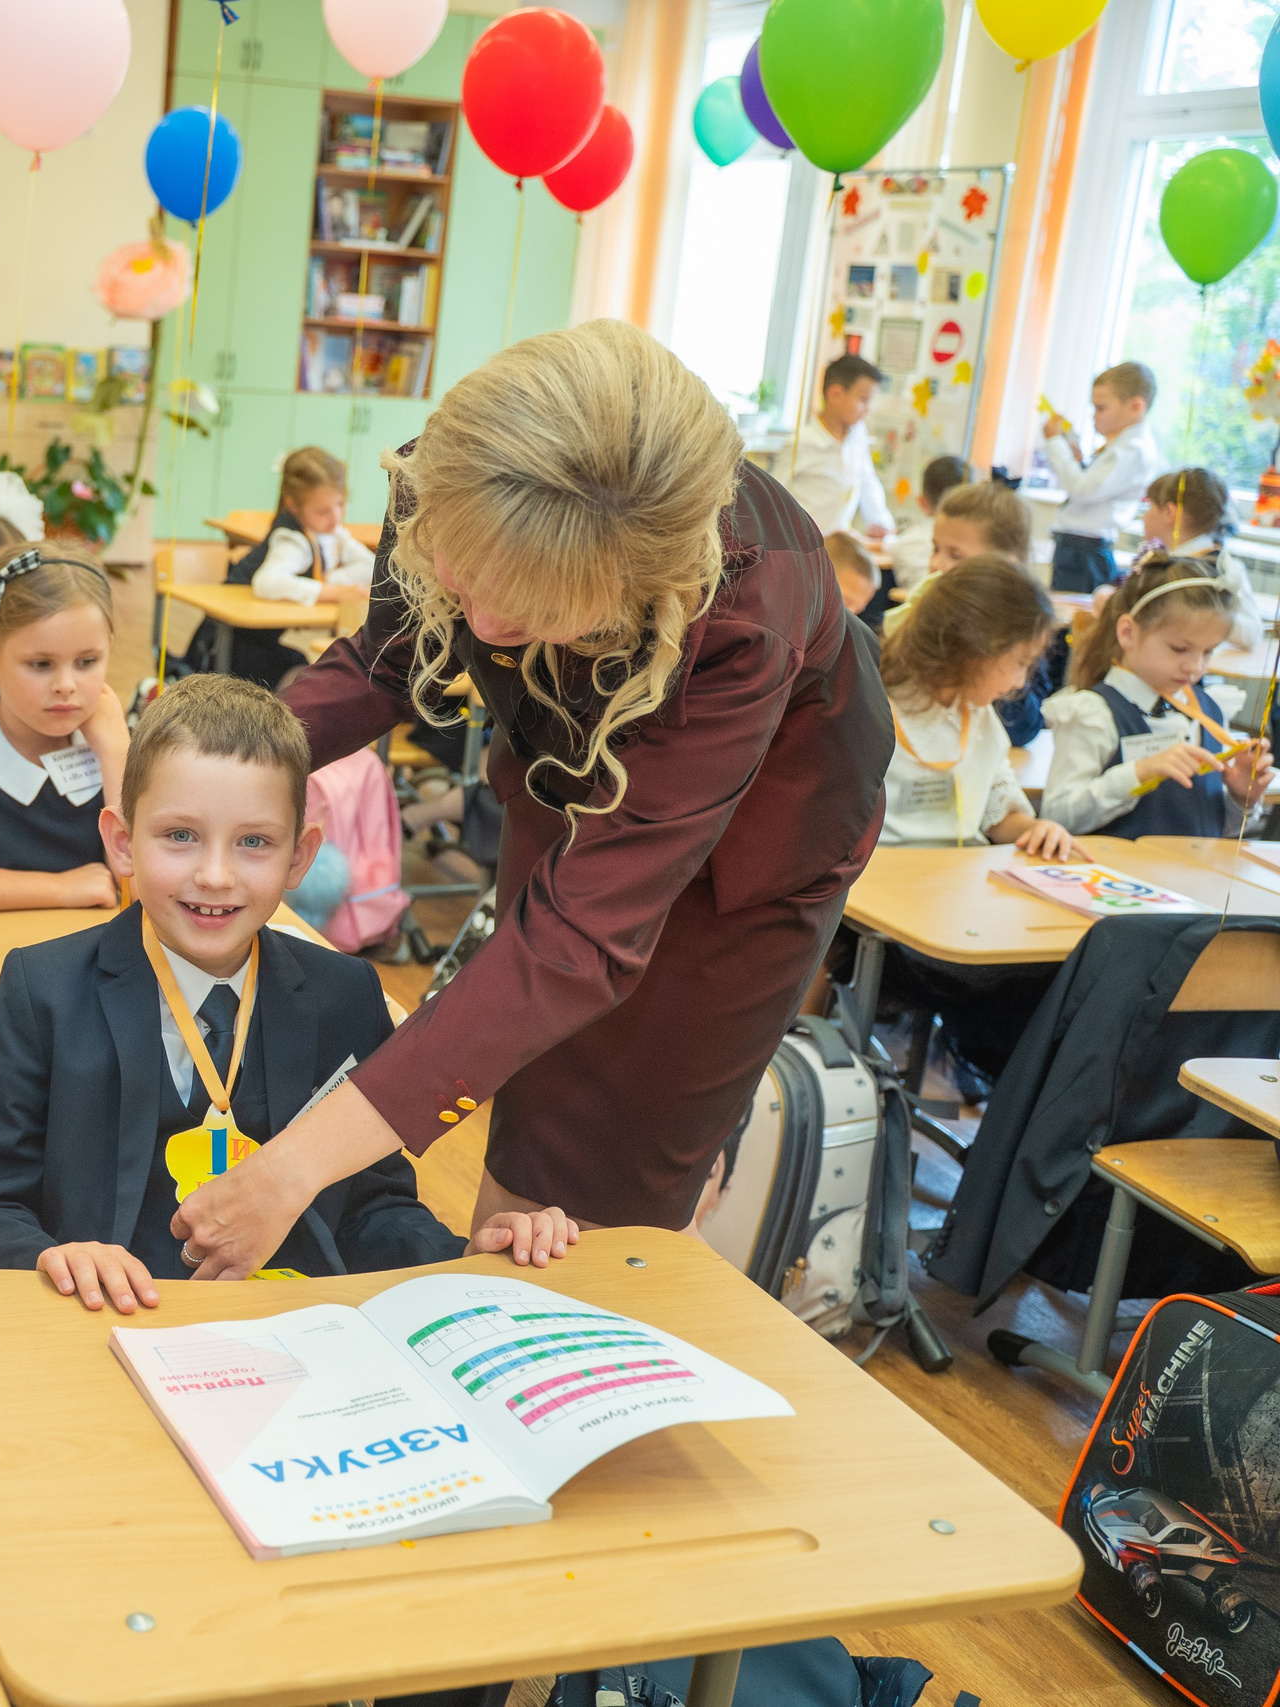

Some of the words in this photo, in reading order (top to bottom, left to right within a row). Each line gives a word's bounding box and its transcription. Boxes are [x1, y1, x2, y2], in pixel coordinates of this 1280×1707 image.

[158, 1369, 228, 1382] обучения
[230, 1366, 256, 1375] год
[1141, 1319, 1215, 1435] MACHINE
[165, 1376, 266, 1395] Первый
[630, 1403, 642, 1411] и
[644, 1395, 693, 1409] Звуки
[578, 1408, 629, 1432] буквы
[249, 1423, 470, 1483] АЗБУКА
[407, 1495, 460, 1516] ШКОЛА
[346, 1512, 404, 1532] РОССИИ
